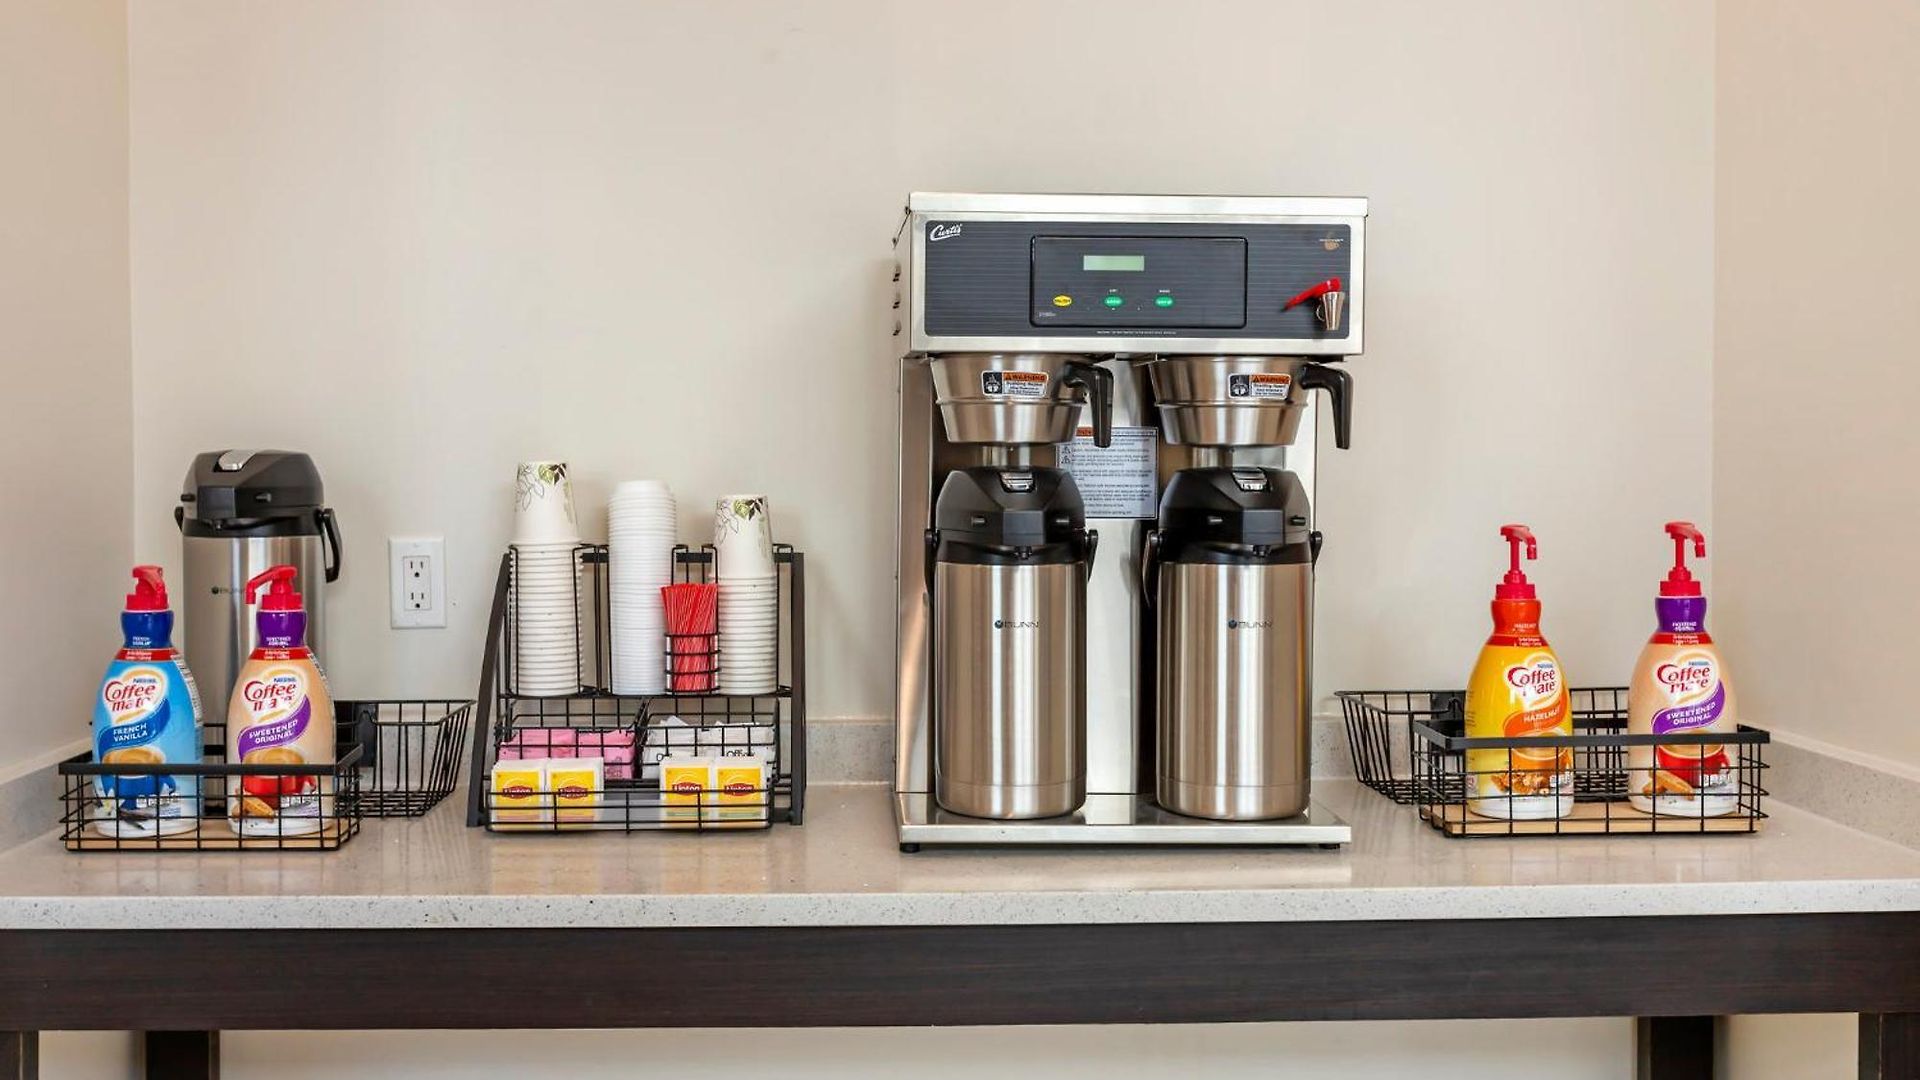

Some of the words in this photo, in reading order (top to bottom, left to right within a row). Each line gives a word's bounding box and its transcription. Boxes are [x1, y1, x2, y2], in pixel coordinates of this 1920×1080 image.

[930, 224, 961, 241] Curtis
[1508, 666, 1556, 688] Coffee
[1657, 664, 1711, 685] Coffee
[105, 680, 157, 702] Coffee
[244, 680, 297, 702] Coffee
[1523, 706, 1561, 724] HAZELNUT
[1666, 701, 1717, 720] SWEETENED
[1673, 712, 1712, 725] ORIGINAL
[113, 722, 148, 736] FRENCH
[113, 731, 148, 742] VANILLA
[249, 719, 299, 739] SWEETENED
[255, 730, 295, 744] ORIGINAL
